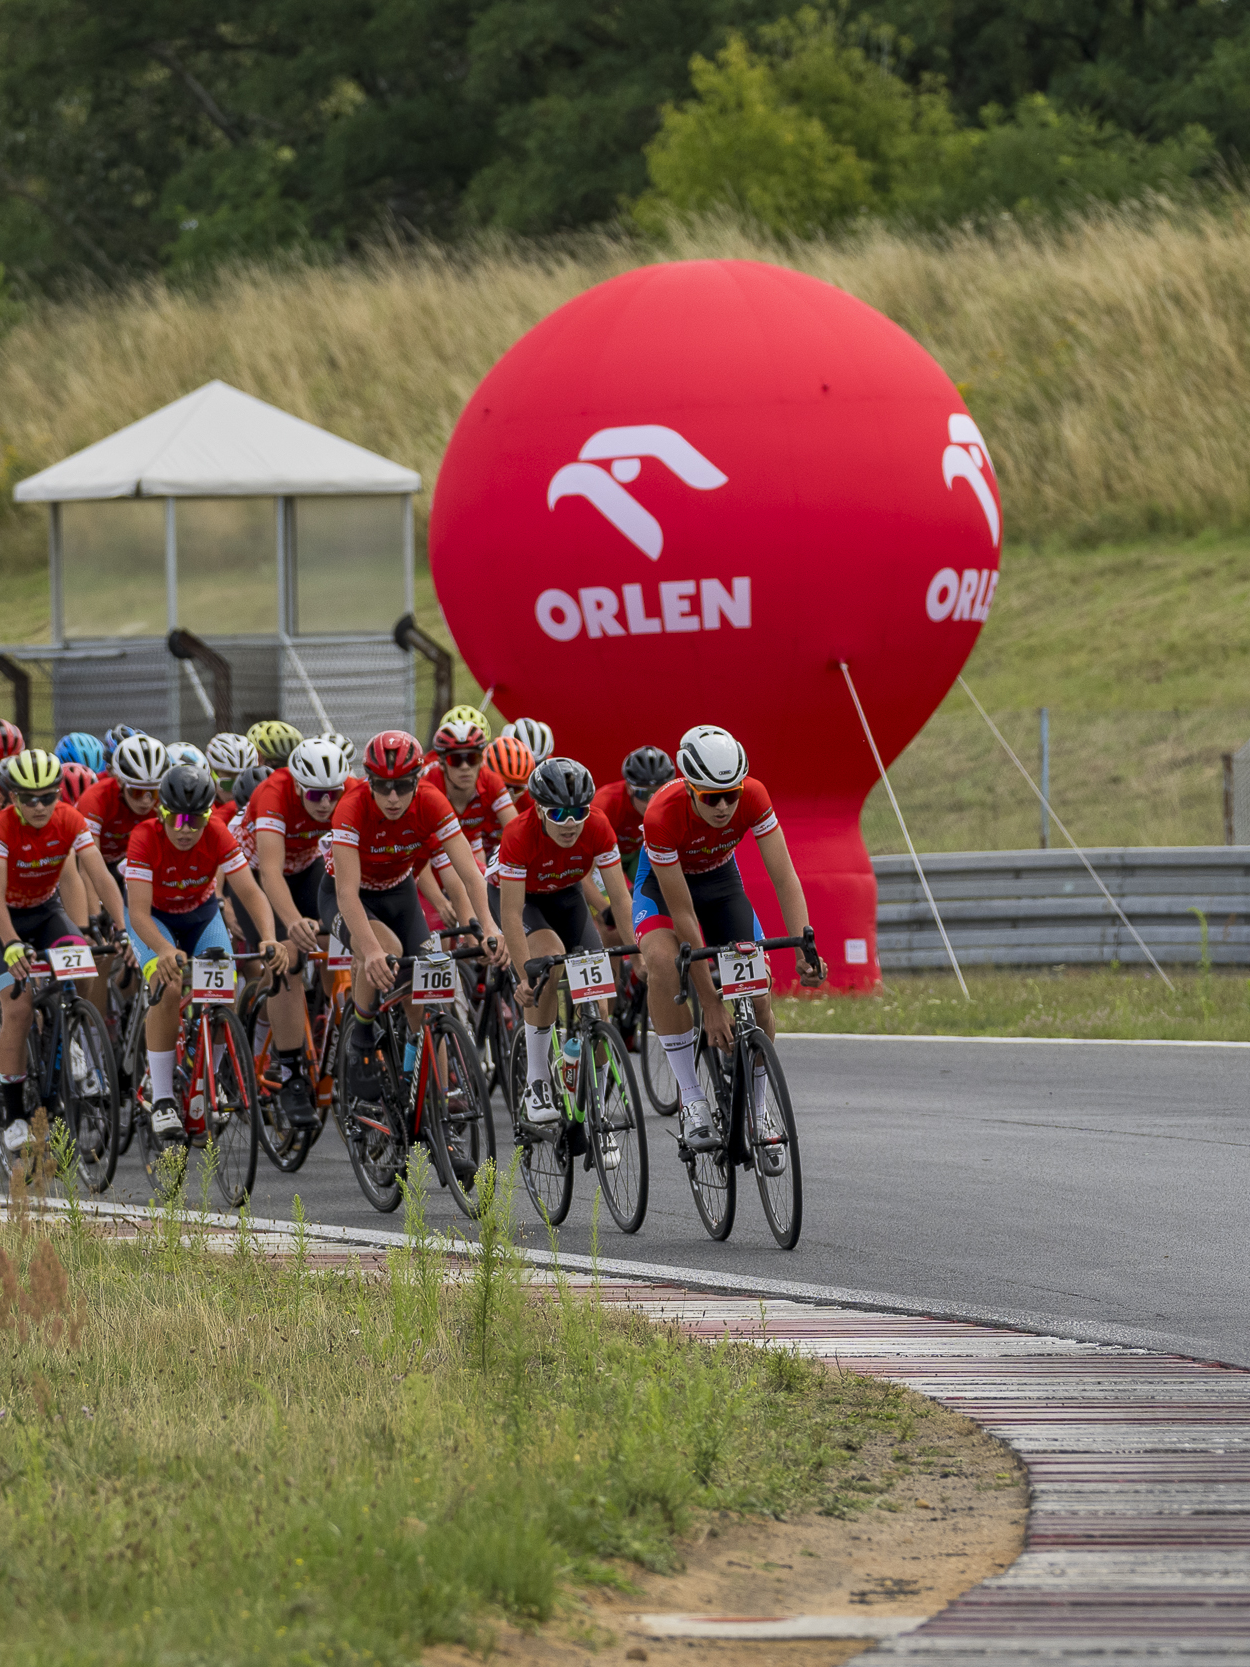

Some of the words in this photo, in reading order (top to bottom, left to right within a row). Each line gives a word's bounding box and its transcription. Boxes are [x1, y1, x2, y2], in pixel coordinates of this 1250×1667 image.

[535, 577, 751, 641] ORLEN
[62, 954, 81, 968] 27
[204, 971, 224, 989] 75
[421, 971, 452, 989] 106
[579, 966, 602, 986] 15
[733, 960, 754, 982] 21
